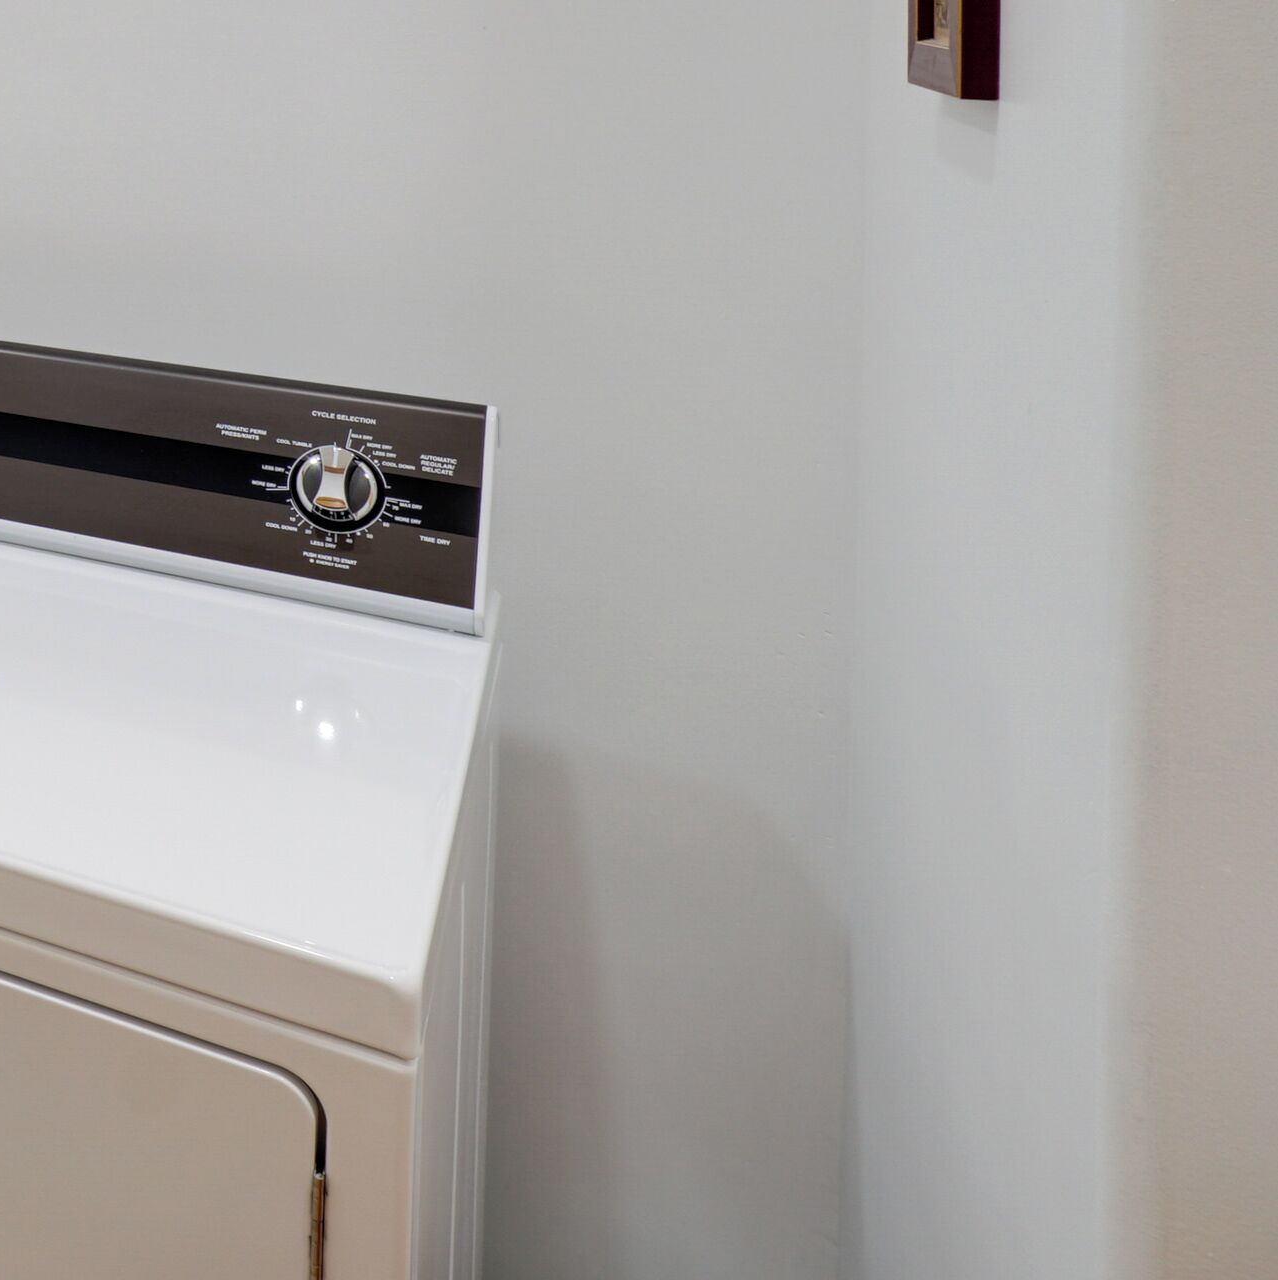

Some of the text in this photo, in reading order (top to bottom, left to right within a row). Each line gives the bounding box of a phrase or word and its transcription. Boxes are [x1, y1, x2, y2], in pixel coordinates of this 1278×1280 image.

[311, 410, 377, 425] CYCLE SELECTION
[215, 423, 267, 436] AUTOMATIC PERM
[292, 440, 312, 448] TUMBLE
[420, 454, 457, 465] AUTOMATIC
[421, 466, 454, 476] DELICATE
[420, 535, 451, 546] TIME DRY
